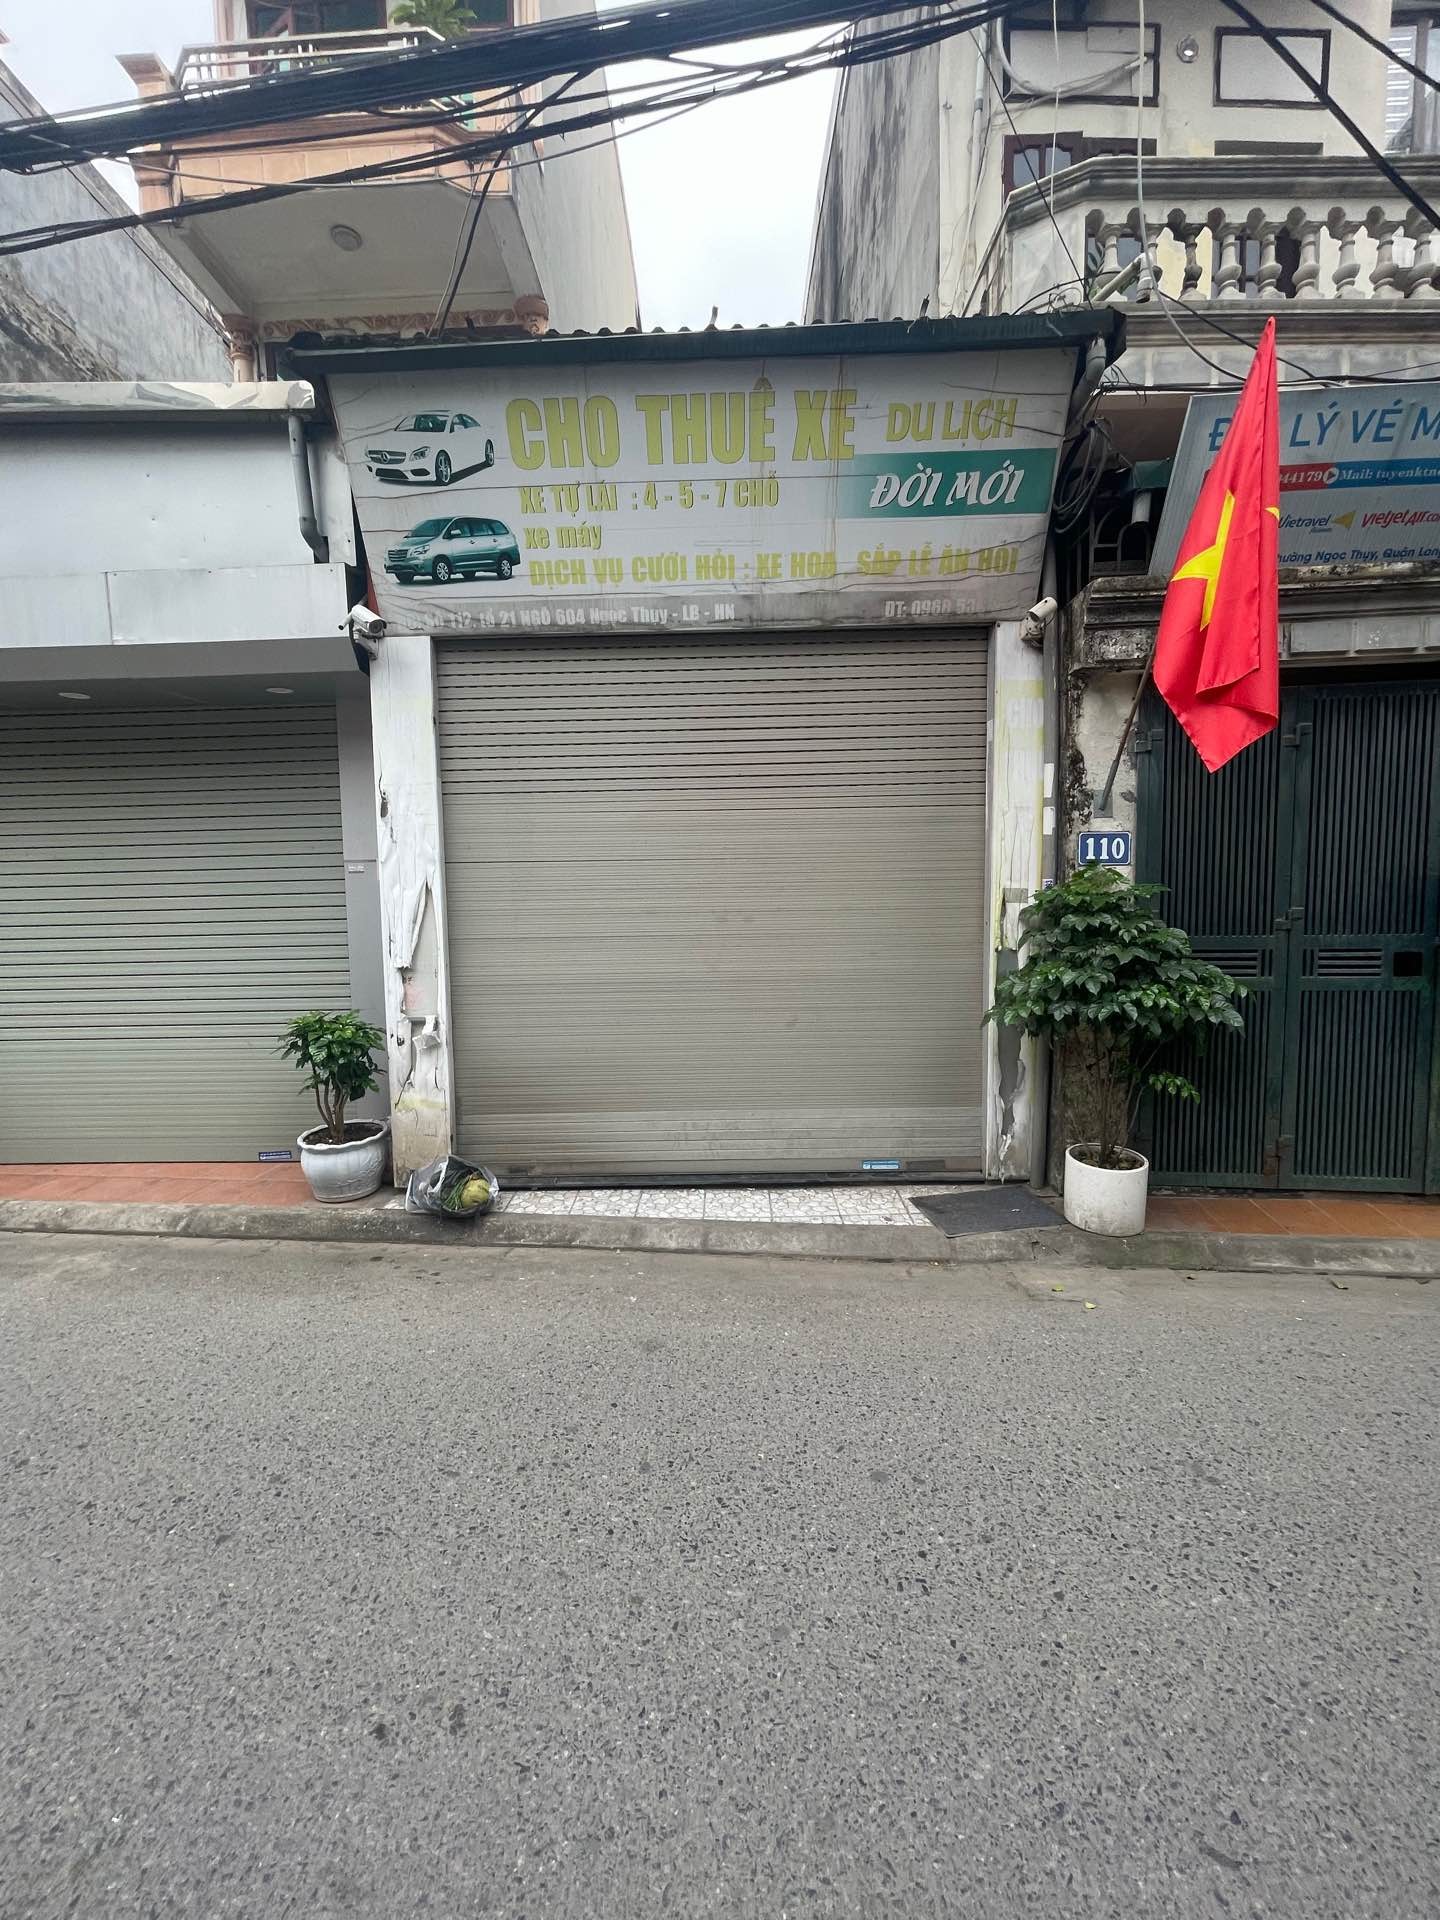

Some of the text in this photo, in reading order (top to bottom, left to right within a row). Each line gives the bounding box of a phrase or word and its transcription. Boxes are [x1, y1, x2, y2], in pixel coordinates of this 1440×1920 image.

[506, 377, 857, 470] CHO THUÊ XE
[886, 399, 1019, 448] DU LỊCH
[1289, 401, 1341, 447] LÝ
[1352, 398, 1404, 443] VÉ
[869, 460, 1025, 508] ĐỜI MỚI
[1340, 468, 1374, 480] Mail:
[520, 486, 547, 514] XE
[552, 481, 582, 518] TỰ
[586, 480, 619, 513] LÁI
[643, 482, 658, 511] 4
[679, 480, 694, 509] 5
[716, 479, 728, 508] 7
[733, 470, 779, 508] CHỖ
[524, 521, 601, 550] xe máy
[1278, 513, 1332, 528] Vietravel
[529, 558, 587, 589] DỊCH
[592, 557, 625, 587] VỤ
[756, 553, 783, 579] XE
[500, 610, 516, 628] 21
[556, 608, 586, 625] 604
[1086, 837, 1125, 860] 110
